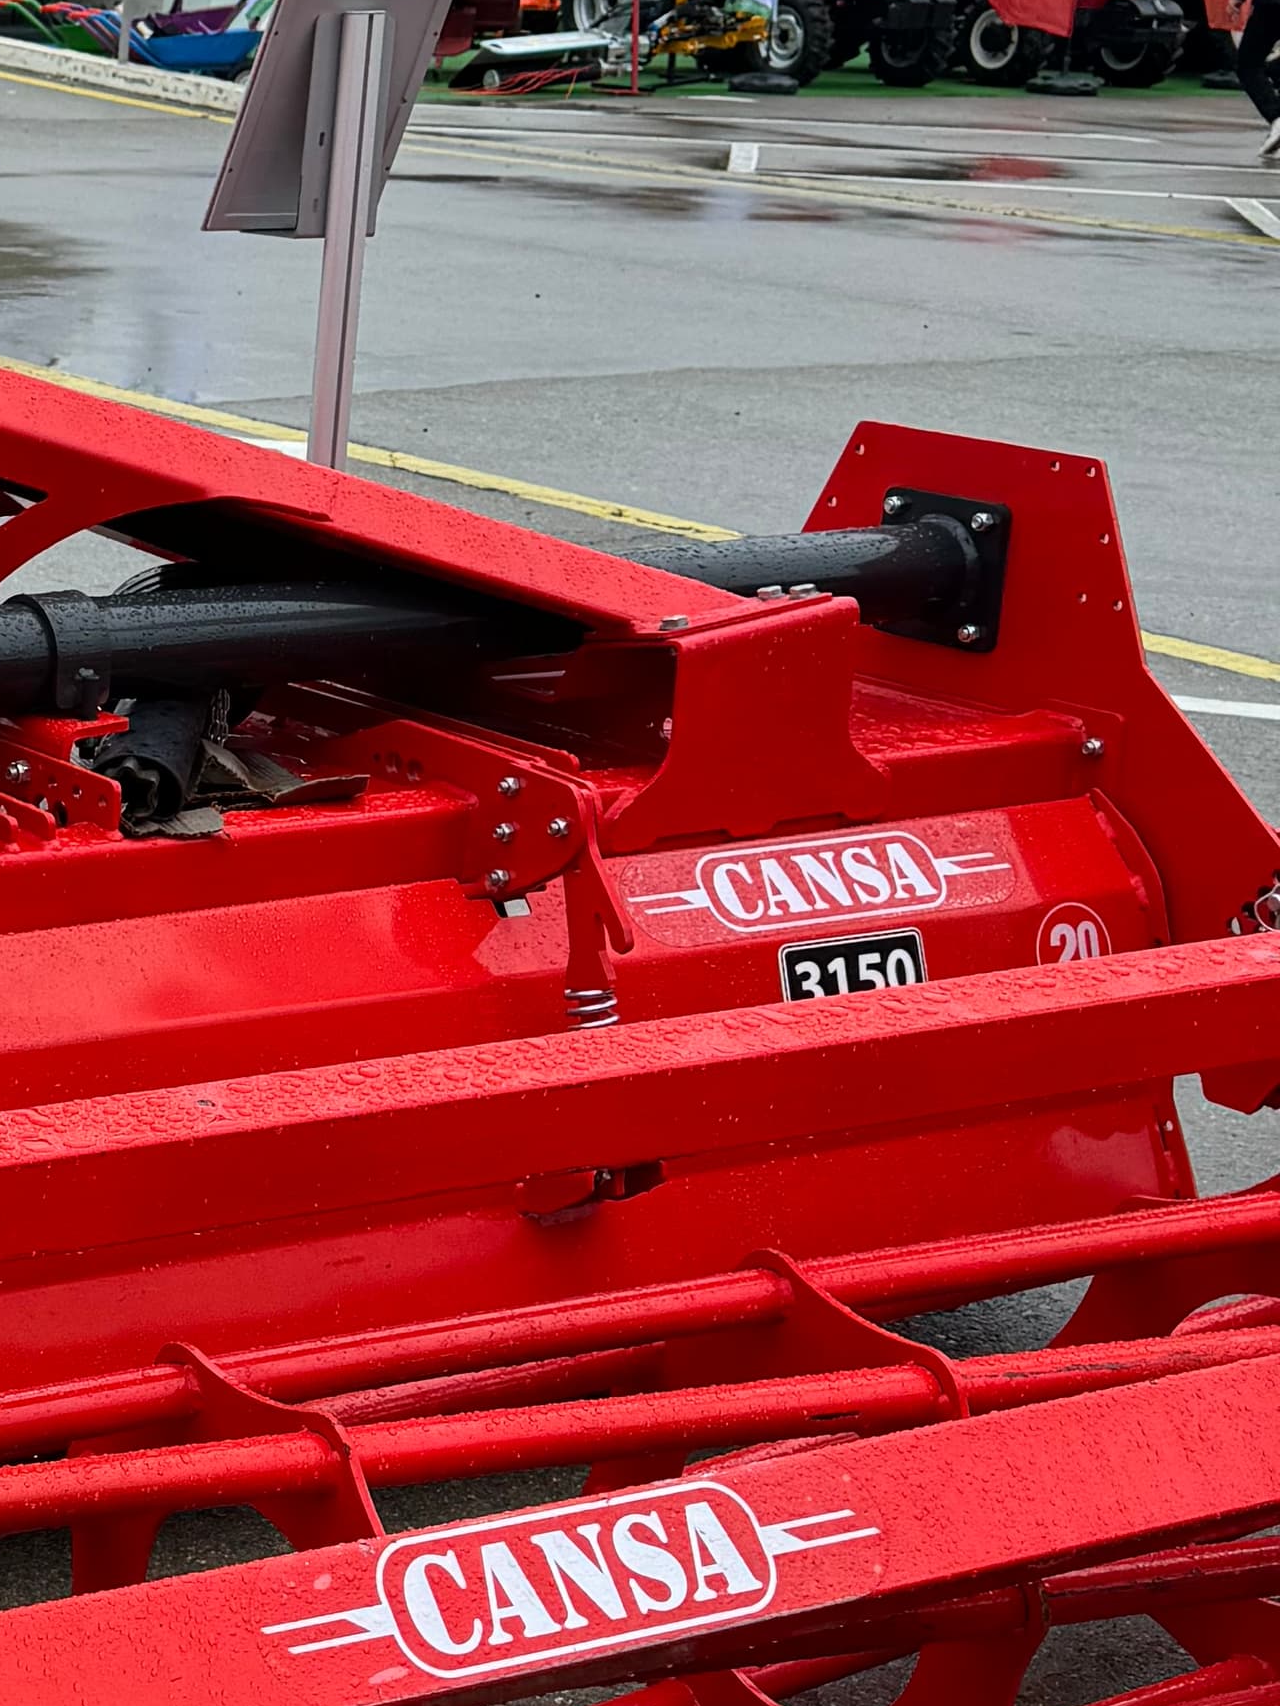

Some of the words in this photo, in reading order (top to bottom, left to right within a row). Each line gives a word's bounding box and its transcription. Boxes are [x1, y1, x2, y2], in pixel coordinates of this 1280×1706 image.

[712, 841, 936, 921] CANSA
[793, 945, 917, 1000] 3150
[1048, 919, 1100, 962] 20
[402, 1500, 764, 1655] CANSA
